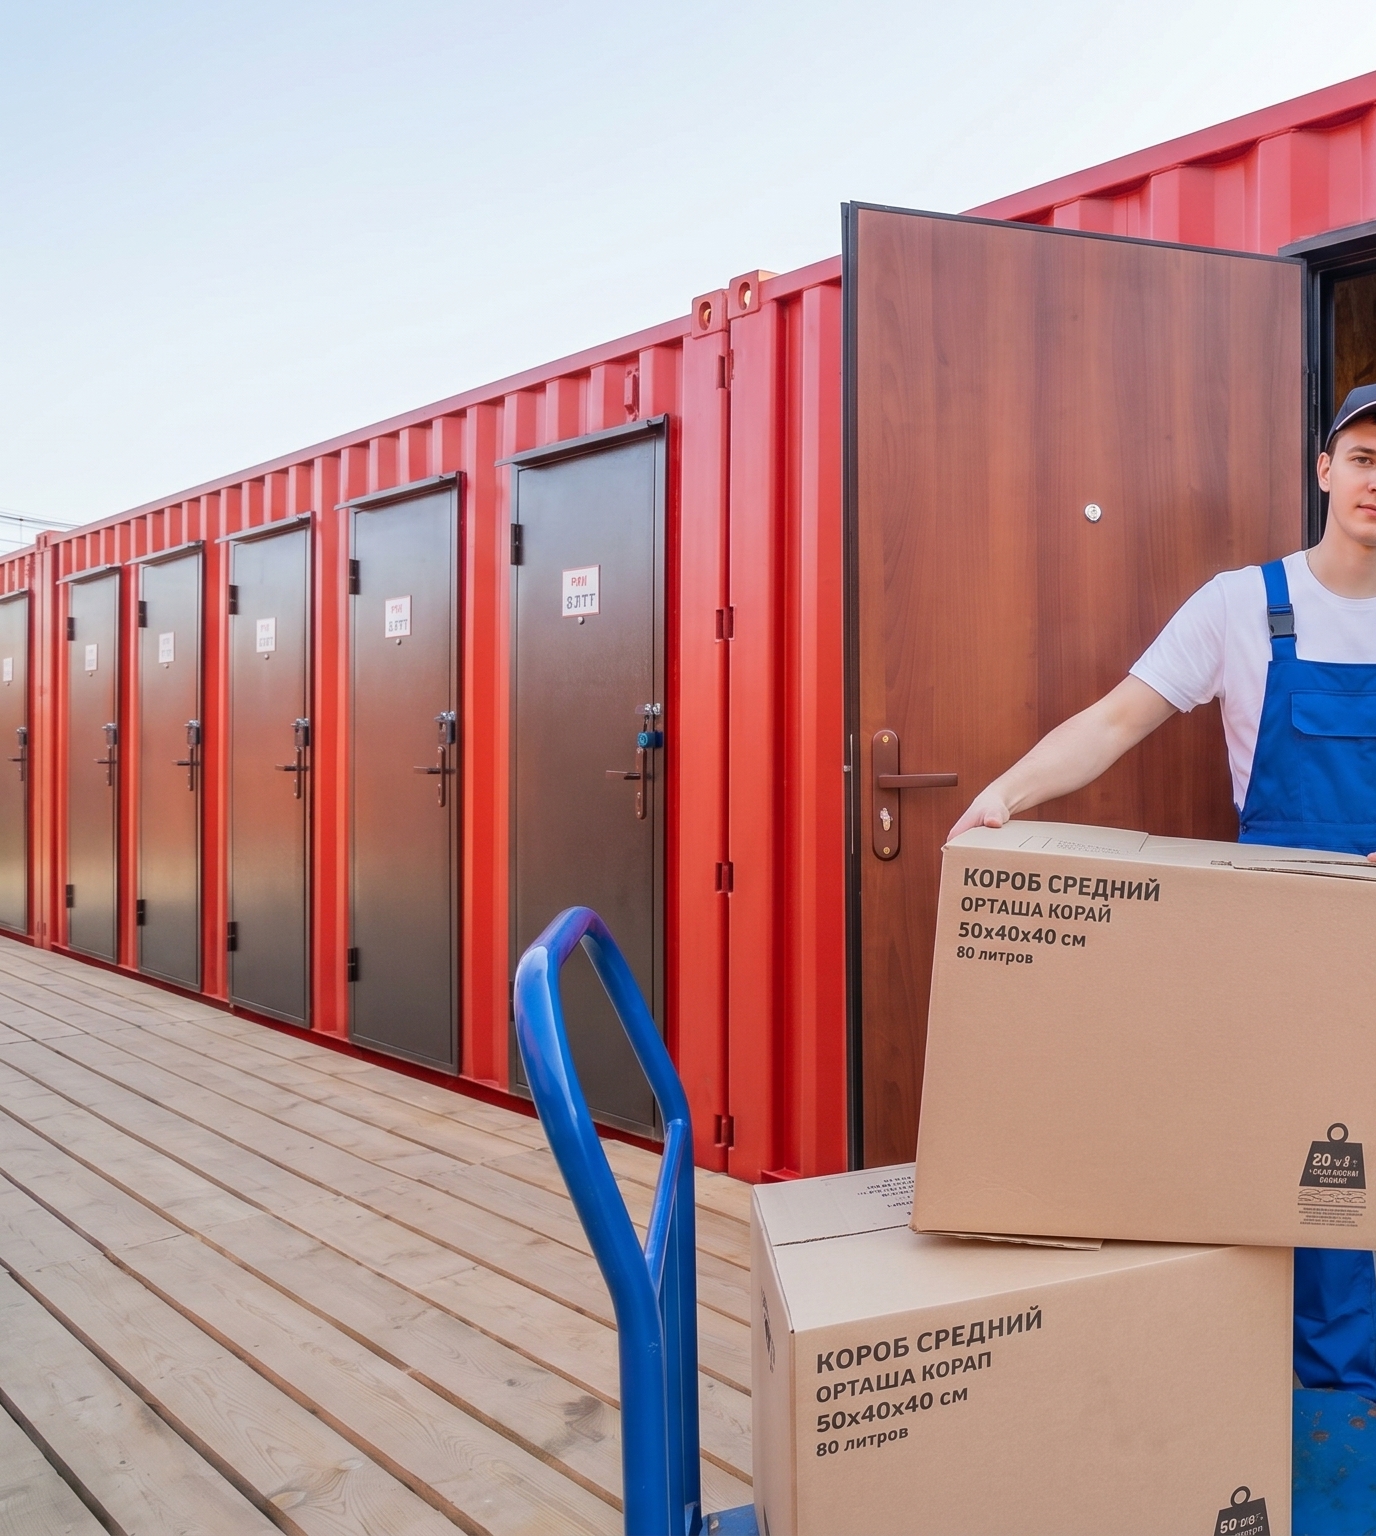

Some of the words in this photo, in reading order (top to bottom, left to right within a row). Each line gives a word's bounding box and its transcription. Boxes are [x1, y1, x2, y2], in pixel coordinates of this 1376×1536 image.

[963, 867, 1042, 892] КОРОБ
[1048, 874, 1161, 902] СРЕДНИЙ
[960, 896, 1044, 918] ОРТАША
[1048, 903, 1112, 923] КОРАЙ
[1060, 933, 1086, 948] см
[956, 945, 975, 959] 80
[977, 949, 1034, 966] литров
[1312, 1152, 1332, 1167] 20
[816, 1336, 910, 1374] КОРОБ
[916, 1304, 1042, 1351] СРЕДНИЙ
[816, 1368, 917, 1403] ОРТАША
[921, 1351, 992, 1382] КОРАП
[939, 1387, 968, 1406] см
[816, 1439, 840, 1457] 80
[843, 1427, 909, 1452] литров
[1219, 1518, 1237, 1534] 50
